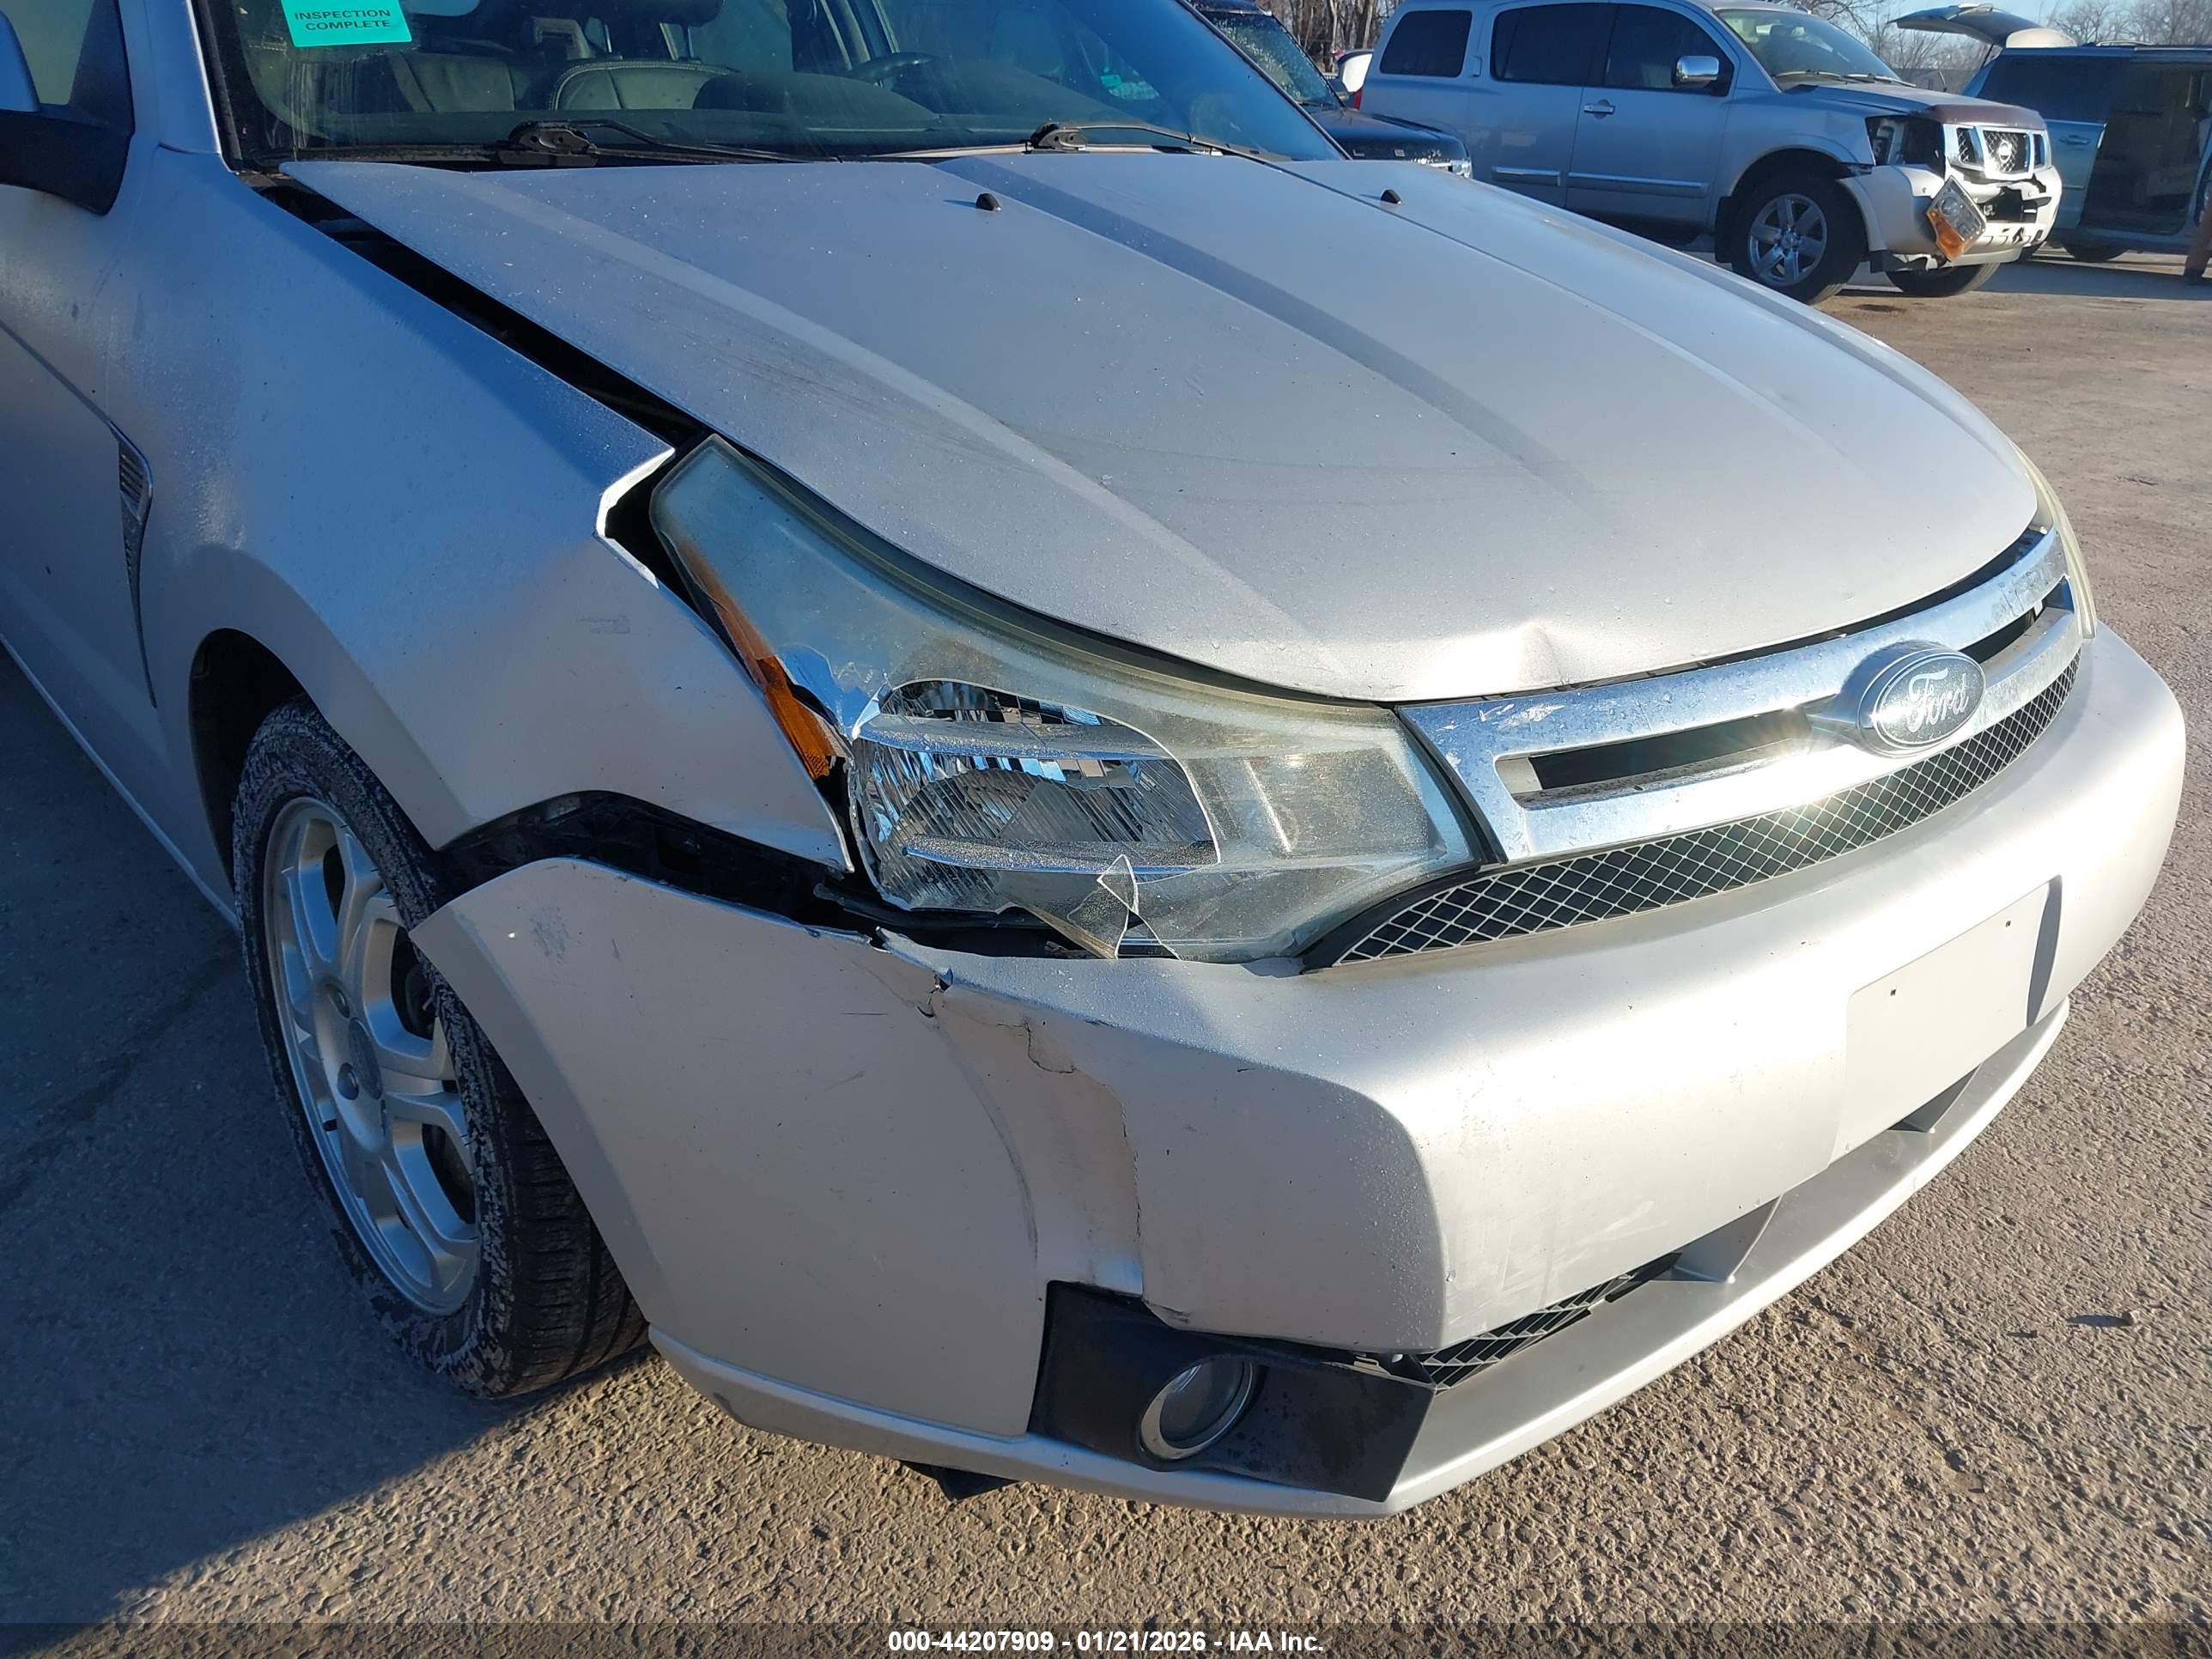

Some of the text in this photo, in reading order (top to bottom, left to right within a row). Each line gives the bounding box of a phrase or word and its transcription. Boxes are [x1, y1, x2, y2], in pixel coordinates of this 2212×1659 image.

[295, 9, 392, 21] INSPECTION
[306, 20, 392, 31] COMPLETE
[1905, 667, 1970, 732] Ford
